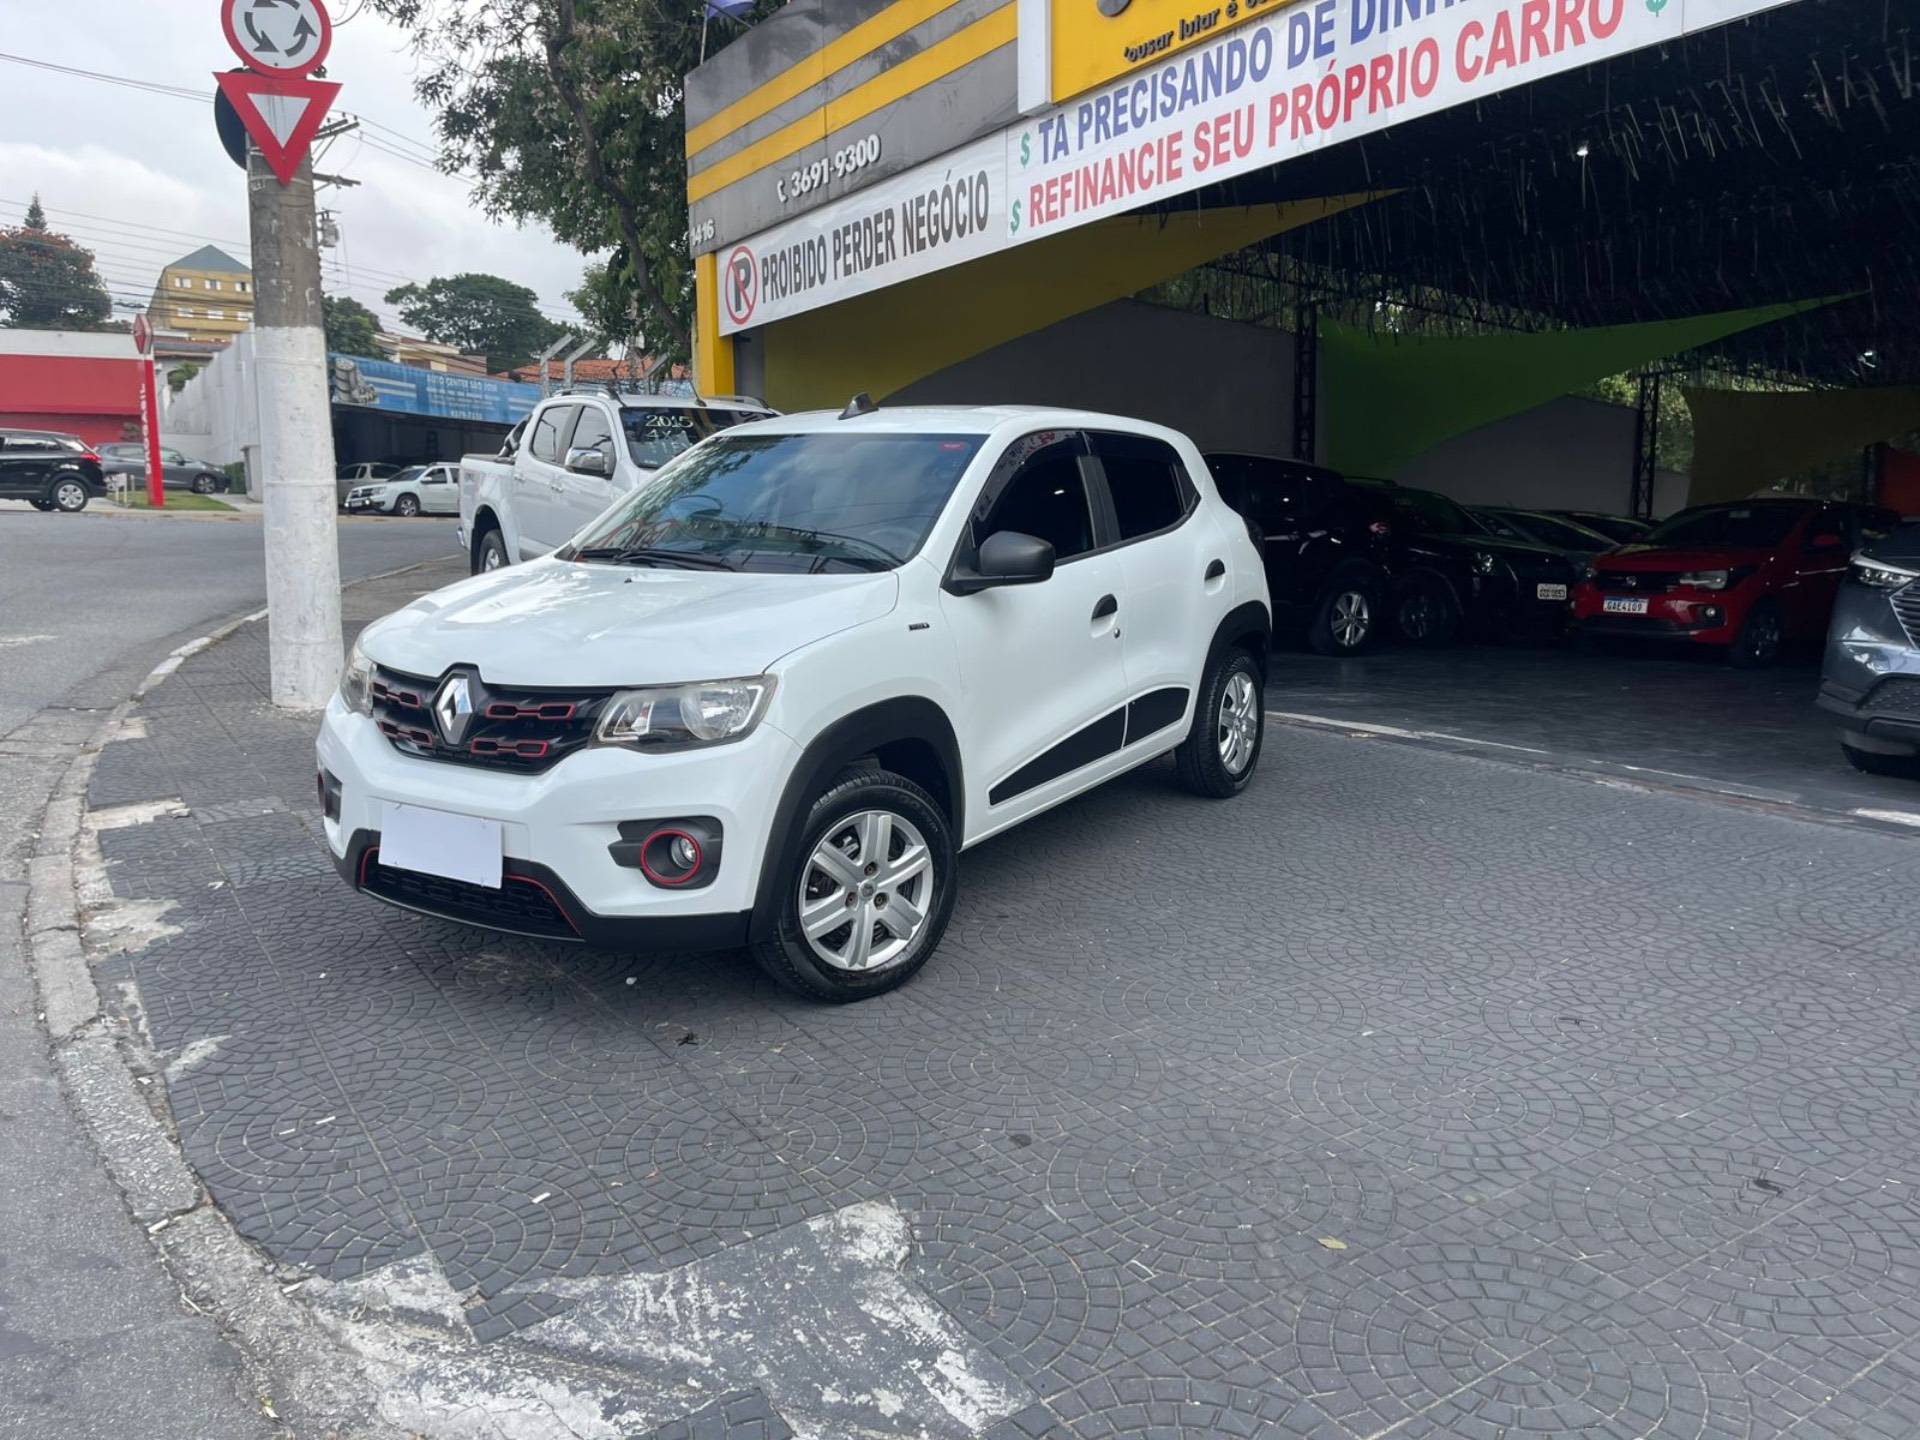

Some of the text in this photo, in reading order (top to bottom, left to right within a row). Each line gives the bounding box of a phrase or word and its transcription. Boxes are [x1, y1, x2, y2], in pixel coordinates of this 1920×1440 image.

[1030, 130, 1183, 228] REFINANCIE
[1192, 103, 1255, 173] SEU
[1268, 37, 1440, 148] PRÓPRIO
[1455, 0, 1625, 83] CARRO
[1038, 114, 1070, 164] TA
[1078, 26, 1273, 151] PRECISANDO
[1287, 0, 1336, 70] DE
[791, 133, 881, 198] 3691-9300
[761, 234, 827, 304] PROIBIDO
[832, 208, 897, 281] PERDER
[902, 169, 990, 257] NEGÓCIO
[645, 414, 694, 428] 2015
